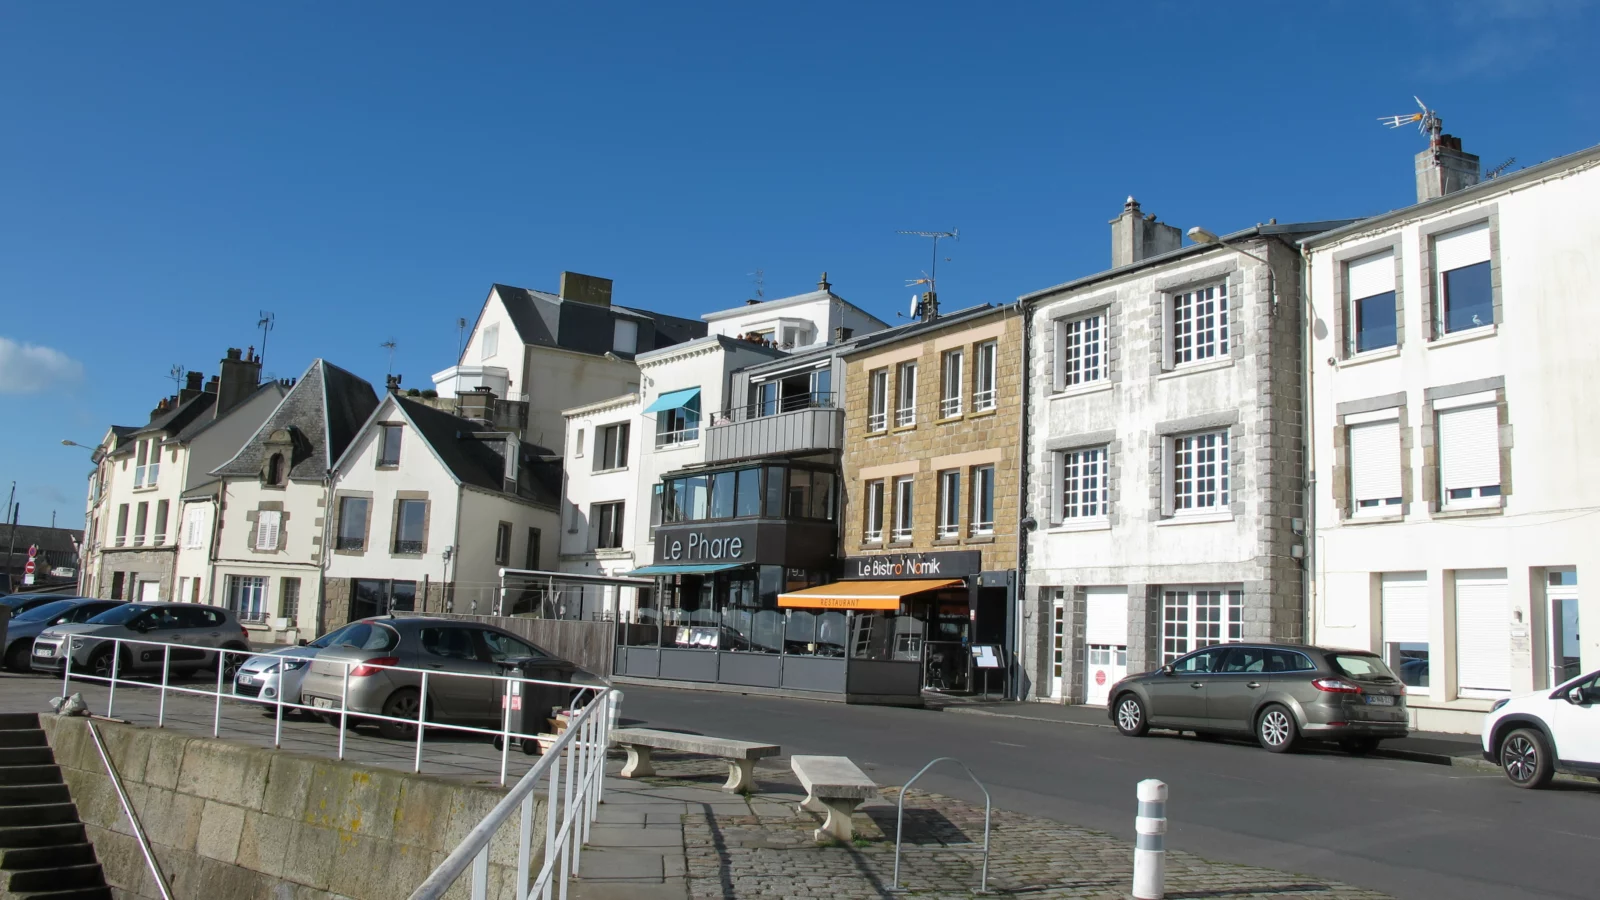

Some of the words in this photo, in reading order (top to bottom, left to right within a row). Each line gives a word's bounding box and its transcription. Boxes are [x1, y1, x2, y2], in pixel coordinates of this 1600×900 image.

[663, 534, 682, 560] Le
[688, 532, 742, 559] Phare
[858, 561, 871, 576] Le
[820, 598, 860, 607] RESTAURANT
